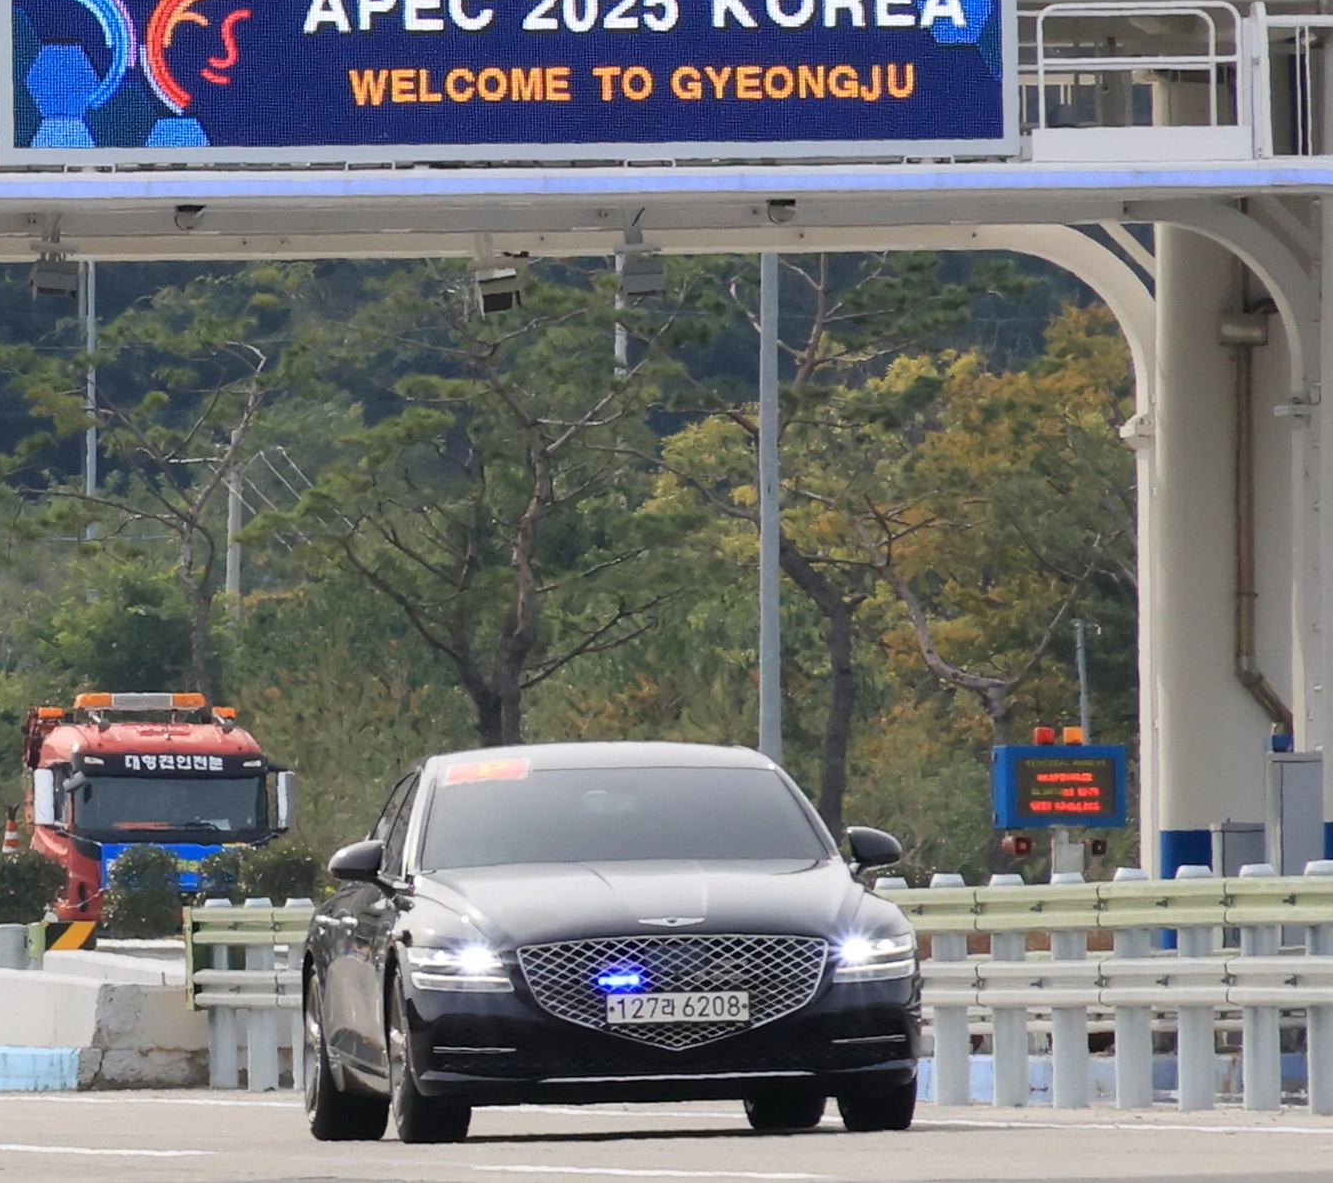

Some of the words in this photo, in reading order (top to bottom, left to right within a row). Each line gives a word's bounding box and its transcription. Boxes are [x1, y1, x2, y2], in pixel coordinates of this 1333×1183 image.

[348, 67, 572, 106] WELCOME
[591, 66, 653, 101] TO
[670, 64, 915, 101] GYEONGJU
[616, 997, 676, 1020] 127라
[682, 995, 741, 1018] 6208
